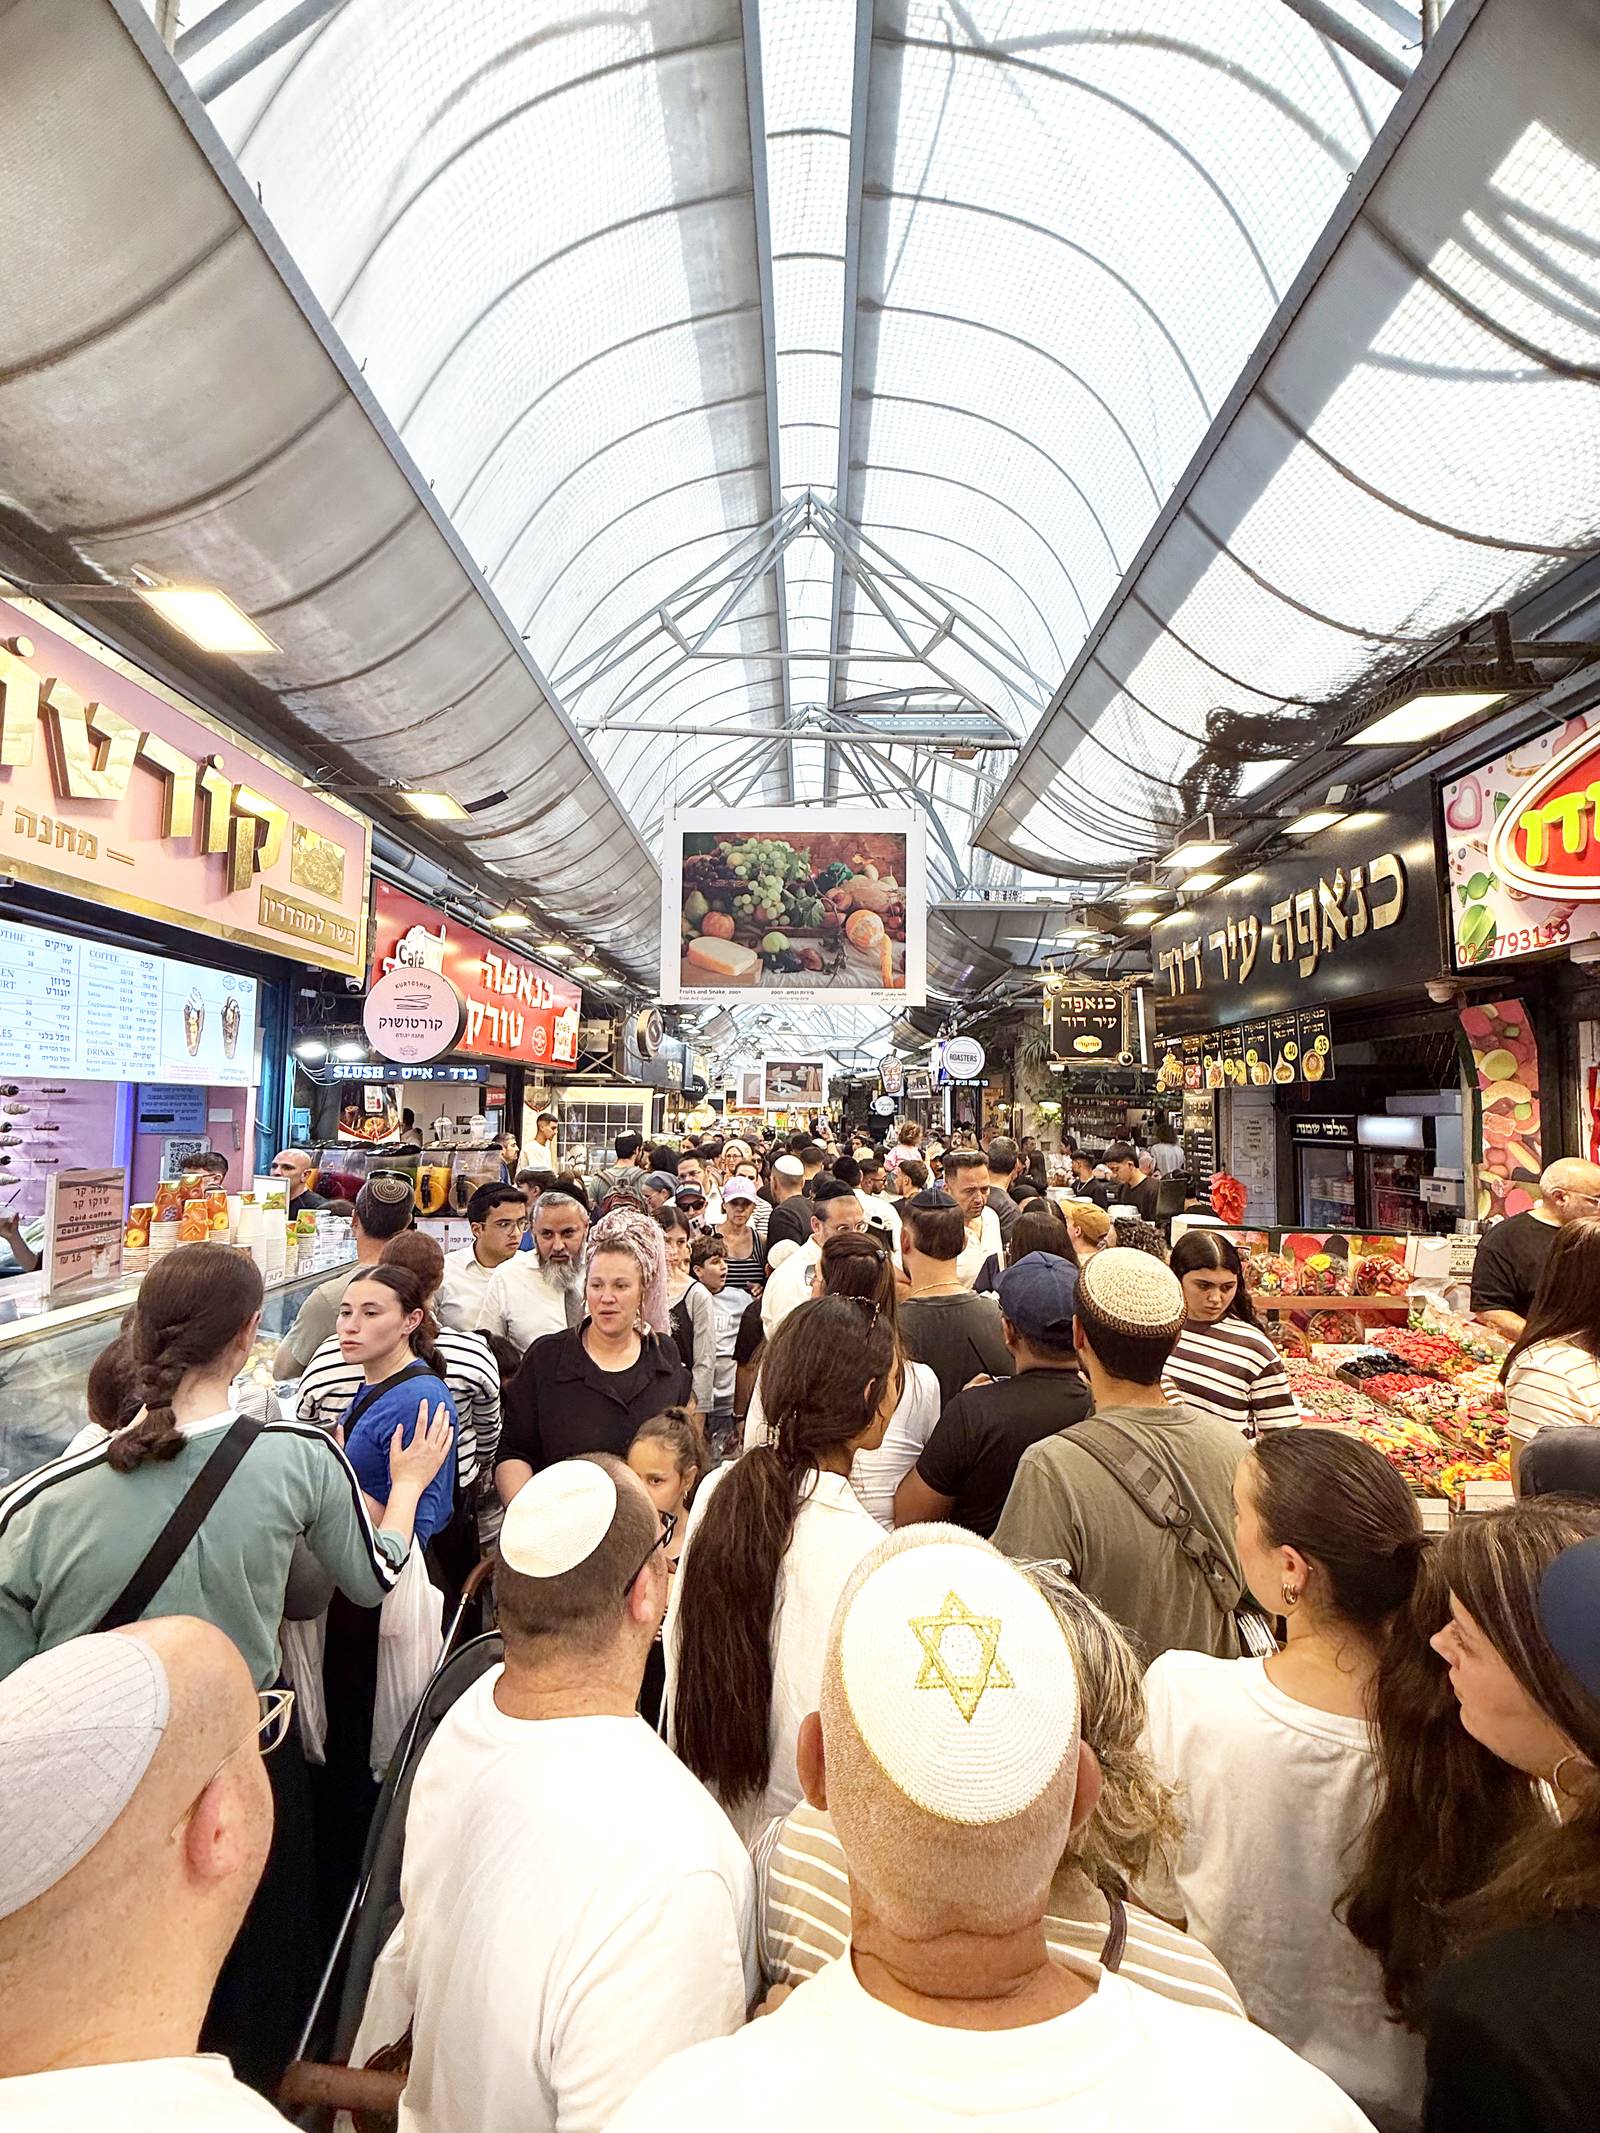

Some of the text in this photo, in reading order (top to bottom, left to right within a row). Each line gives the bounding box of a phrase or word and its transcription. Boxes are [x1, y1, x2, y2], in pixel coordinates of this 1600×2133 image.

[15, 806, 98, 860] מחנה
[264, 896, 355, 946] כשר למהדרין
[1159, 853, 1405, 997] כנאפה עיר דוד
[44, 939, 73, 952] שייקים
[1457, 919, 1571, 965] 02-5793119
[140, 960, 154, 971] קפה
[50, 976, 71, 988] פרוזן
[479, 948, 554, 1010] כנאפה
[46, 986, 71, 998] יוגורט
[1060, 996, 1117, 1013] כנאפה
[1060, 1016, 1118, 1029] עיר דוד
[1318, 1038, 1327, 1052] 35
[87, 1048, 115, 1057] DRINKS
[949, 1053, 978, 1062] ROASTERS
[333, 1065, 385, 1079] SLUSH
[401, 1066, 433, 1080] אייס
[449, 1067, 479, 1081] ברד
[1322, 1118, 1349, 1136] מלבי
[75, 1187, 87, 1198] קר
[73, 1196, 110, 1211] שוקו קר
[68, 1212, 87, 1223] Cold
[71, 1253, 82, 1263] 16
